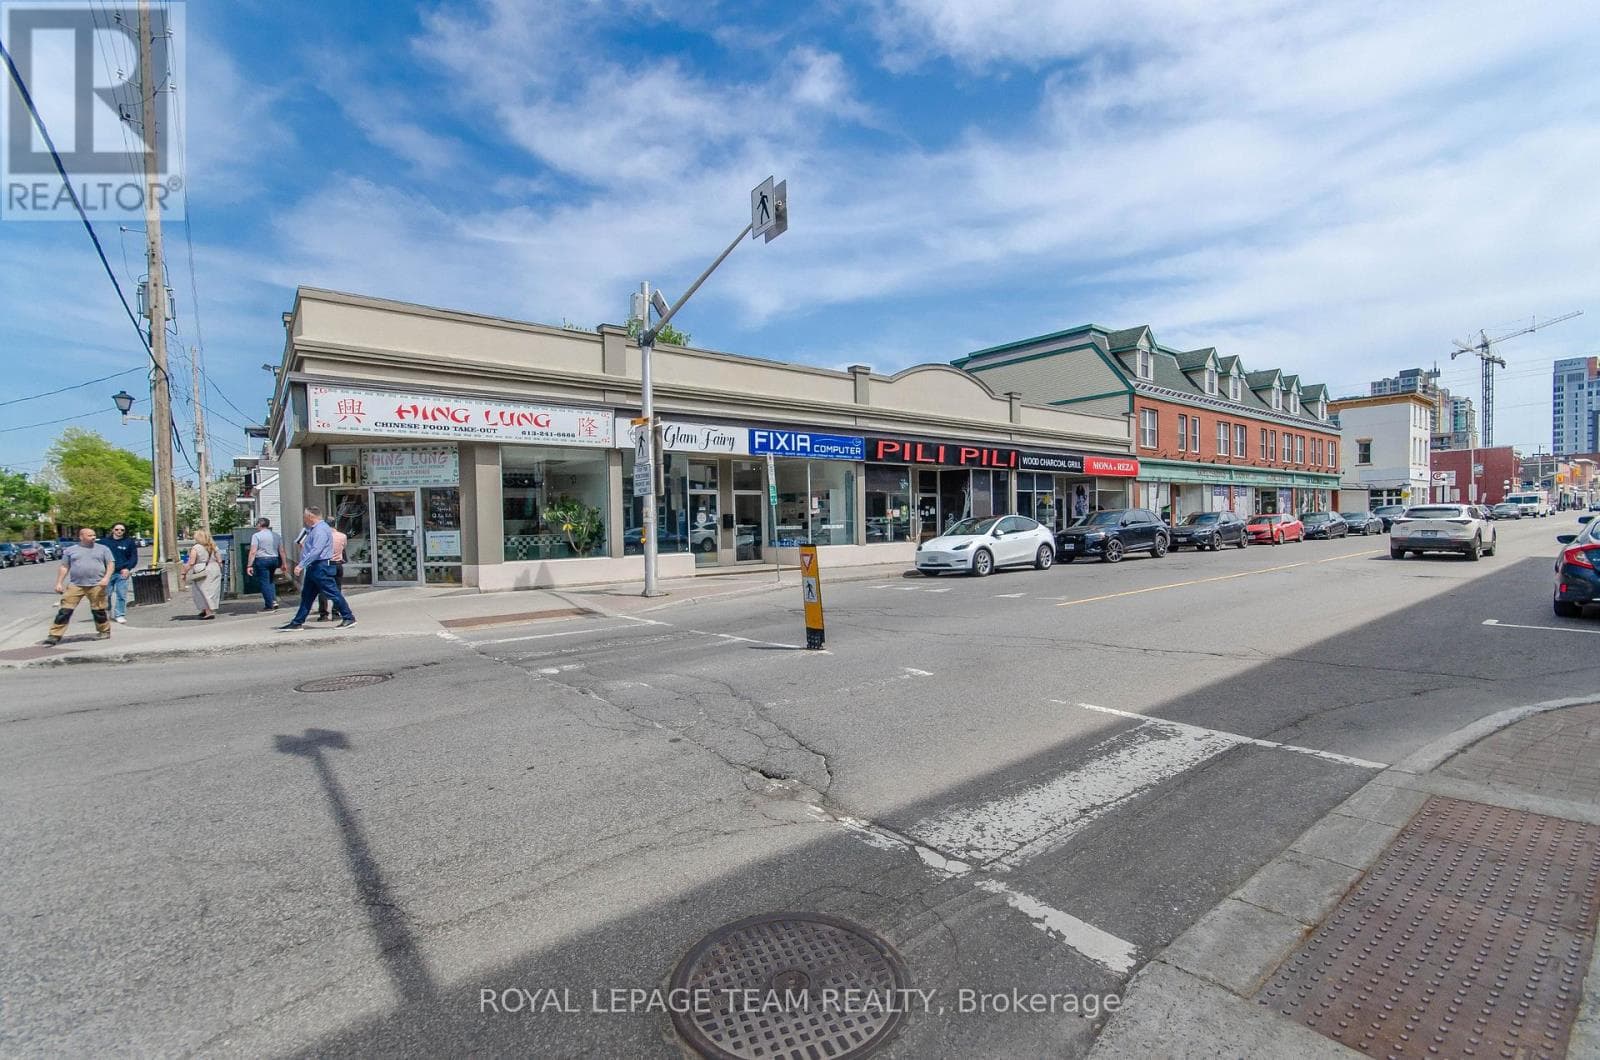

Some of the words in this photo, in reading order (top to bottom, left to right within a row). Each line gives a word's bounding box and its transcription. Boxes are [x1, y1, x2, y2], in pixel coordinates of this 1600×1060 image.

[334, 398, 366, 424] 興
[395, 404, 471, 424] HING
[484, 409, 551, 429] LUNG
[374, 421, 420, 429] CHINESE
[453, 426, 498, 434] TAKE-OUT
[578, 416, 599, 438] 隆
[664, 424, 697, 449] Glam
[699, 427, 735, 451] Fairy
[754, 431, 811, 452] FIXIA
[813, 444, 861, 455] COMPUTER
[876, 440, 945, 463] PILI
[960, 447, 1016, 468] PILI
[371, 453, 405, 466] HING
[411, 452, 448, 466] LUNG
[1022, 456, 1039, 466] WOOD
[1040, 457, 1067, 468] CHARCOAL
[1067, 460, 1081, 468] GRILL
[1092, 461, 1113, 471] MONA
[1117, 462, 1134, 471] REZA
